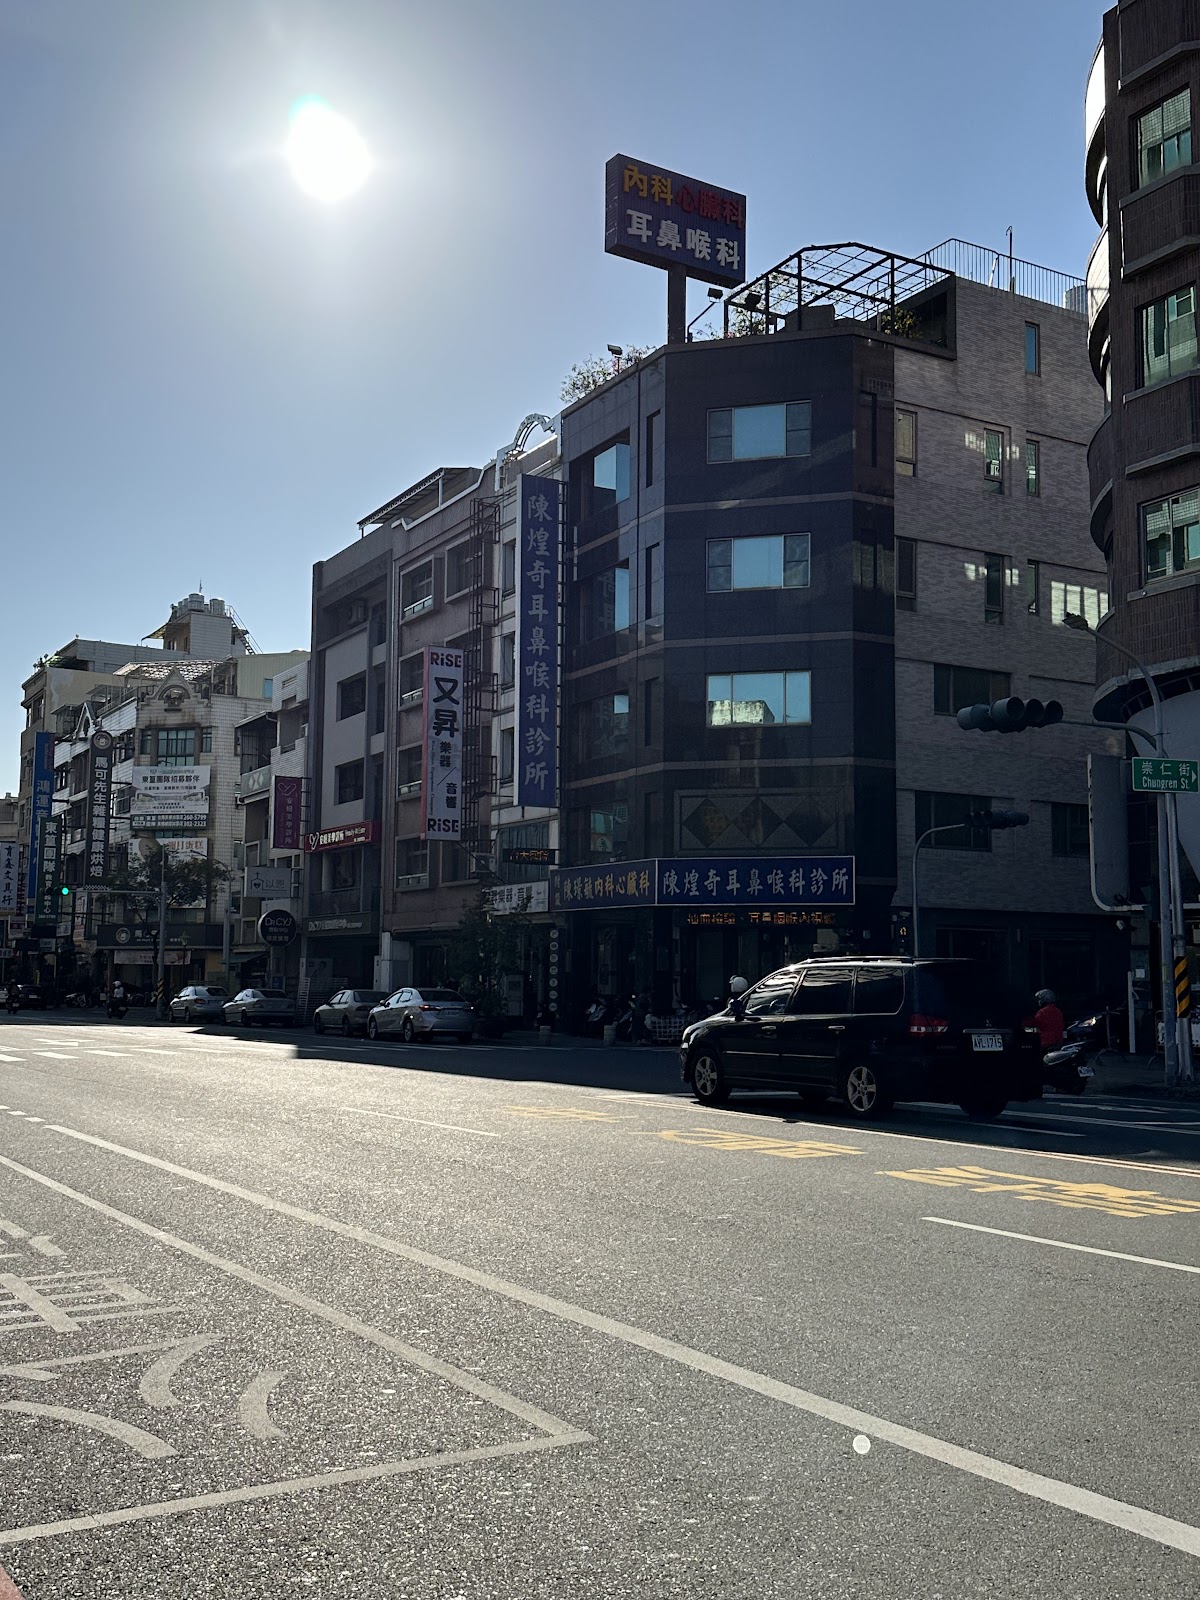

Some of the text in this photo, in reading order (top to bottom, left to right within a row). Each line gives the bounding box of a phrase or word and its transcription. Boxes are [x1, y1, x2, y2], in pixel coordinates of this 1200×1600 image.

[626, 208, 741, 270] 耳鼻喉科
[526, 493, 552, 791] 陳煌奇耳鼻喉科診所
[1141, 760, 1191, 777] 崇仁街
[1142, 776, 1178, 790] Chungren
[427, 818, 459, 833] RiSE
[663, 867, 849, 898] 陳煌奇耳鼻喉科診所
